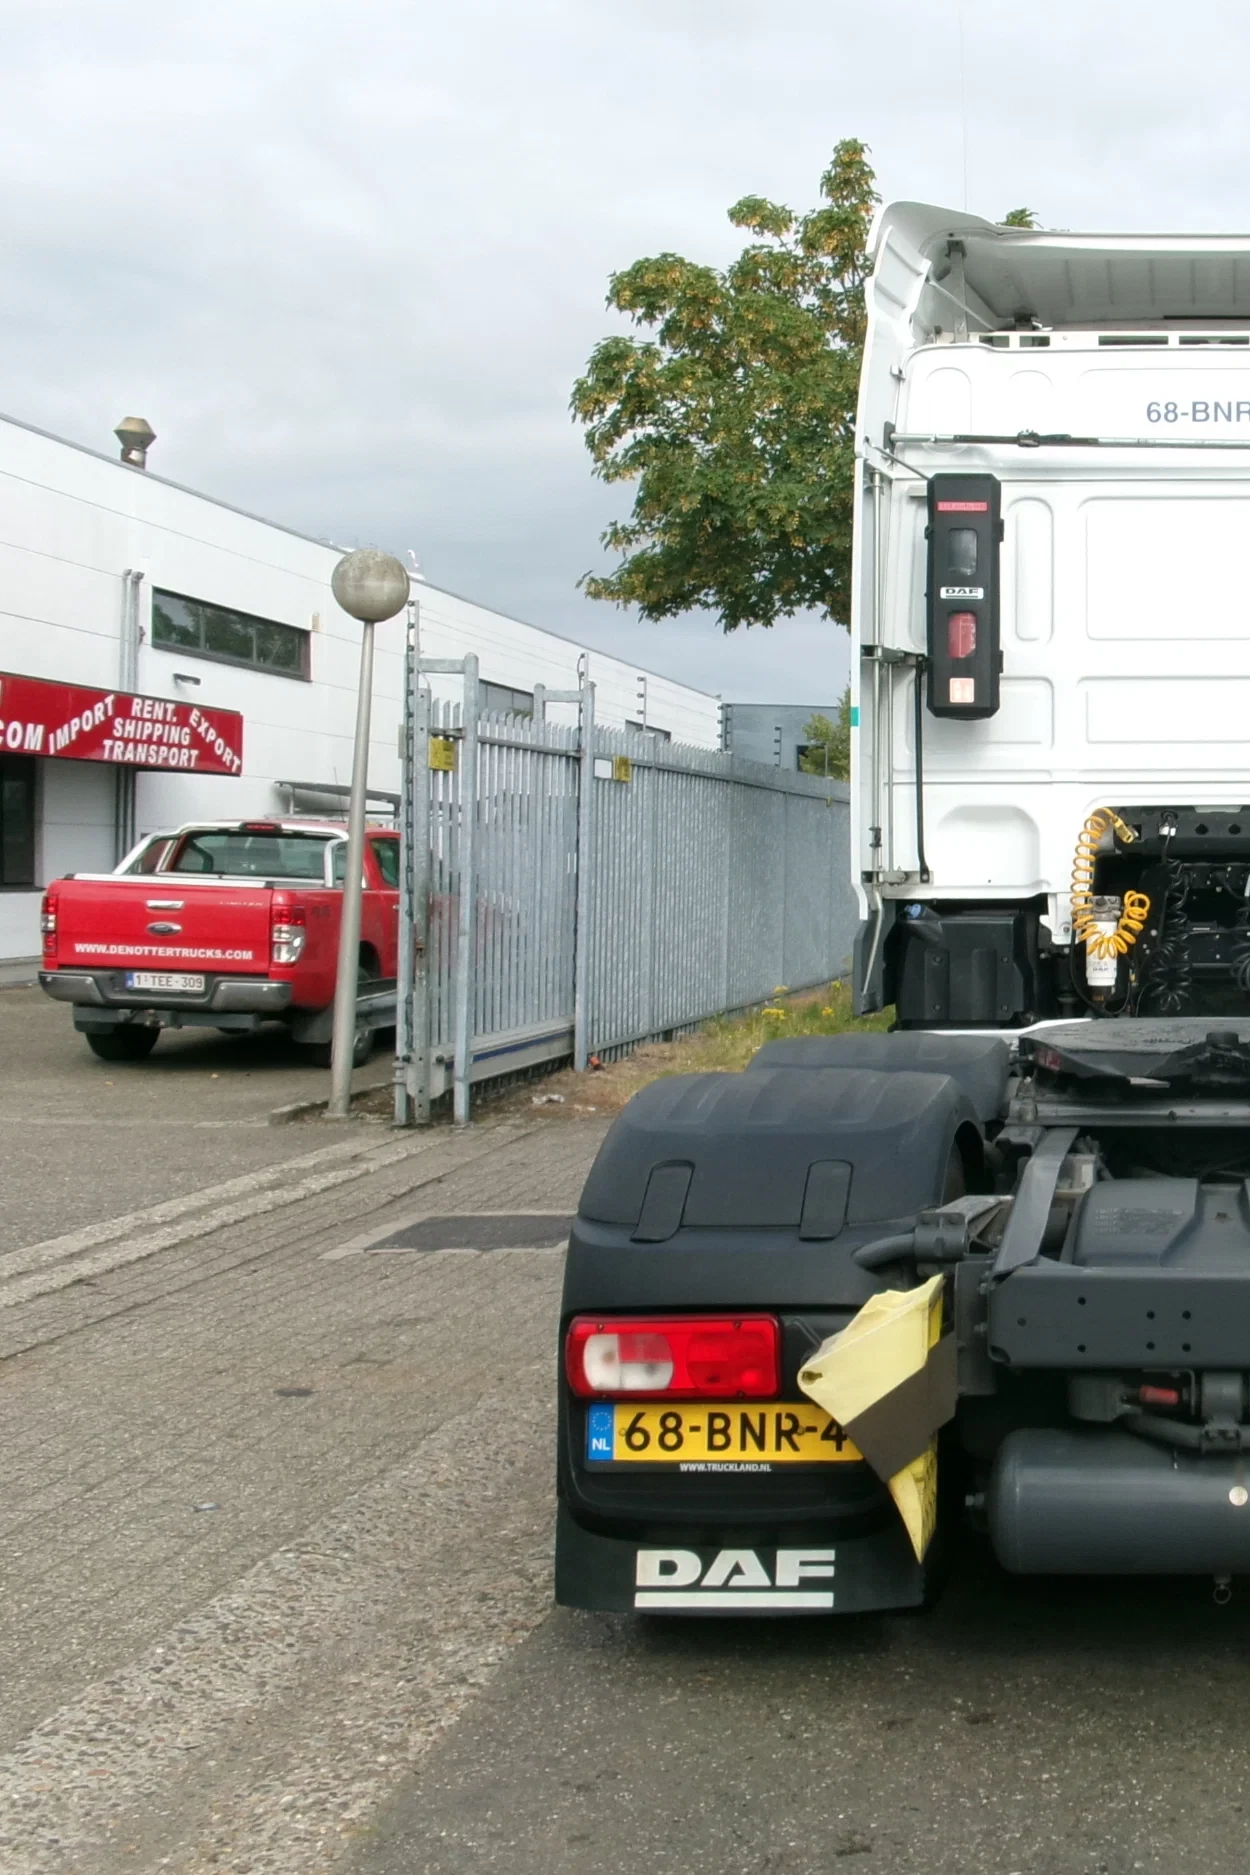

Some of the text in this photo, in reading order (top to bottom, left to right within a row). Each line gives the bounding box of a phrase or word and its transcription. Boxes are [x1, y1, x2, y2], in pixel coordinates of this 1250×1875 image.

[48, 694, 117, 755] IMPORT
[131, 698, 177, 722] RENT.
[0, 719, 44, 751] OM
[112, 718, 191, 746] SHIPPING
[188, 708, 242, 773] EXPORT
[102, 739, 200, 768] TRANSPORT
[74, 942, 253, 960] WWW.DENOTTERTRUCKS.COM
[592, 1411, 848, 1453] NL 68-BNR-4
[679, 1462, 772, 1473] WWW.TRUCKLAND.NL
[636, 1549, 836, 1587] DAF
